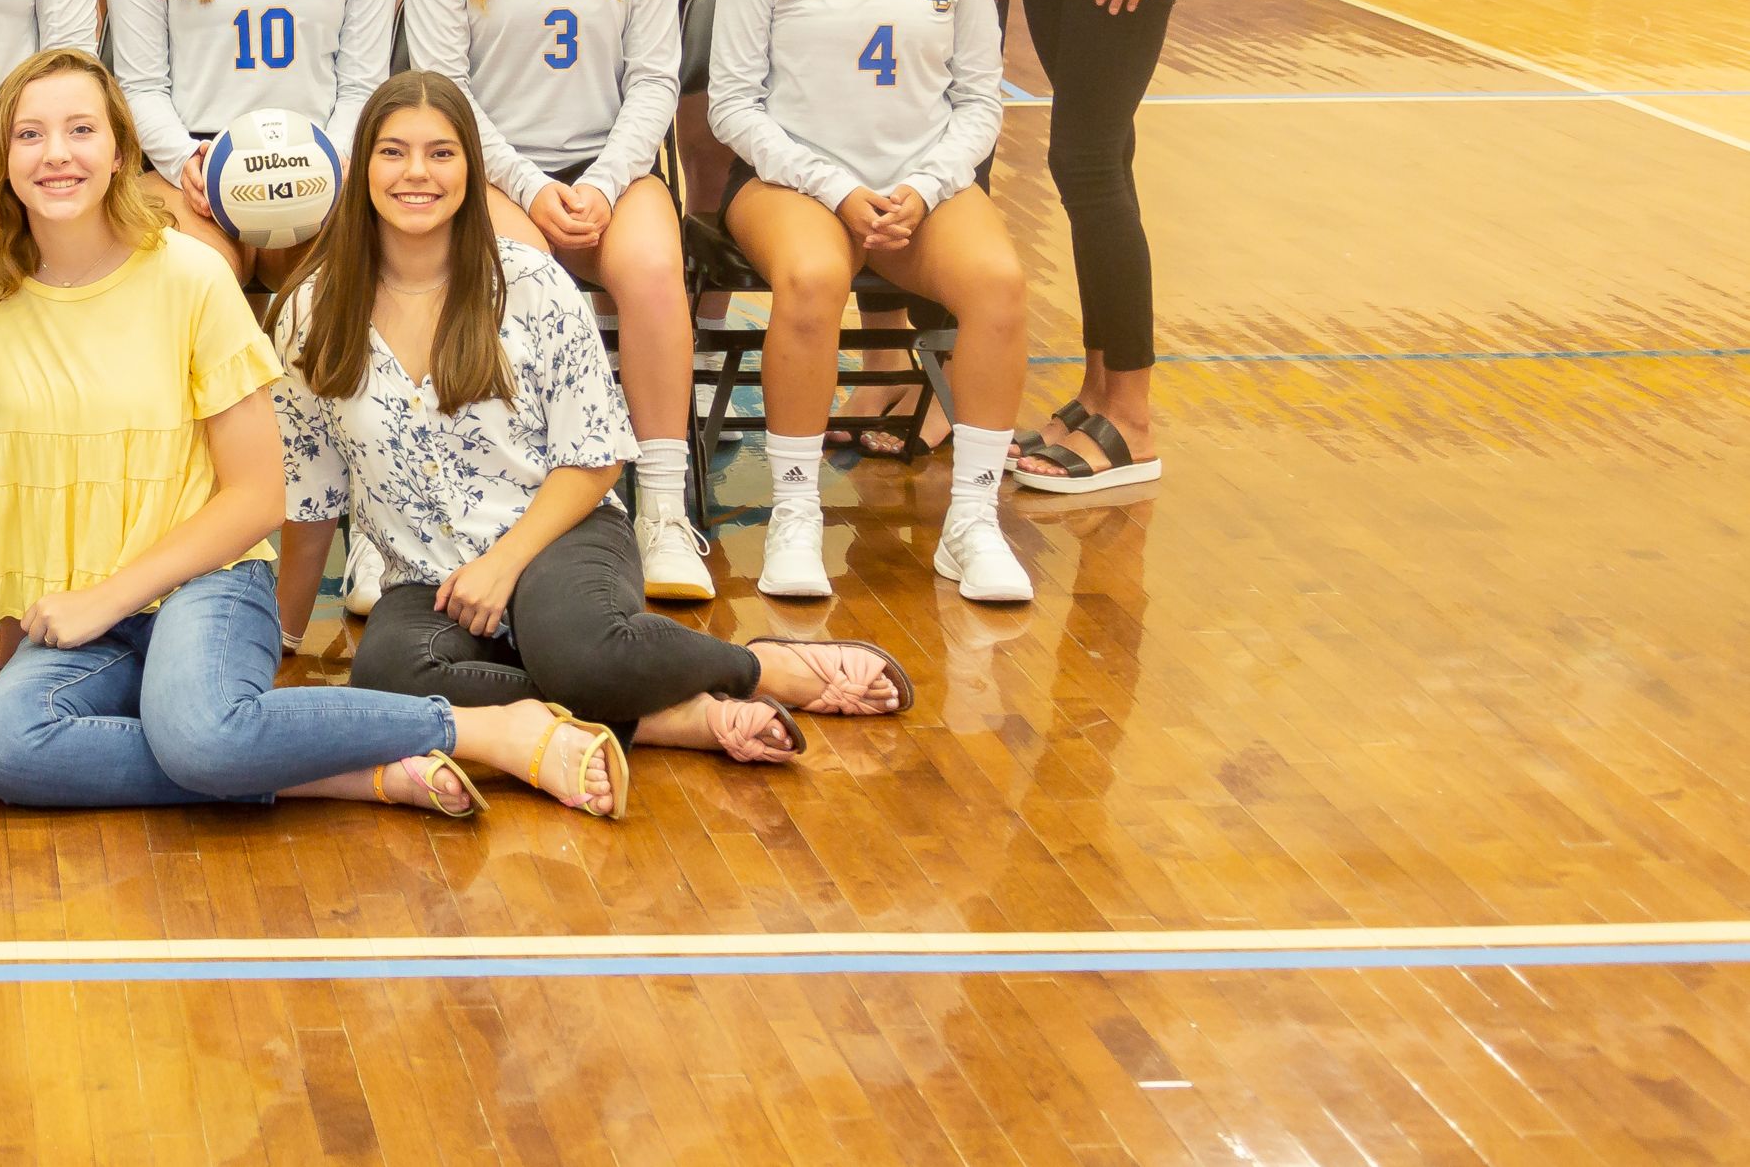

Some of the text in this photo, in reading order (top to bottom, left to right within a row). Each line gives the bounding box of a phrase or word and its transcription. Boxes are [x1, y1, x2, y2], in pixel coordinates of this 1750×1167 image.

[232, 6, 296, 71] 10
[542, 7, 580, 71] 3
[856, 22, 899, 87] 4
[244, 153, 311, 172] Wilson
[268, 182, 294, 200] K1
